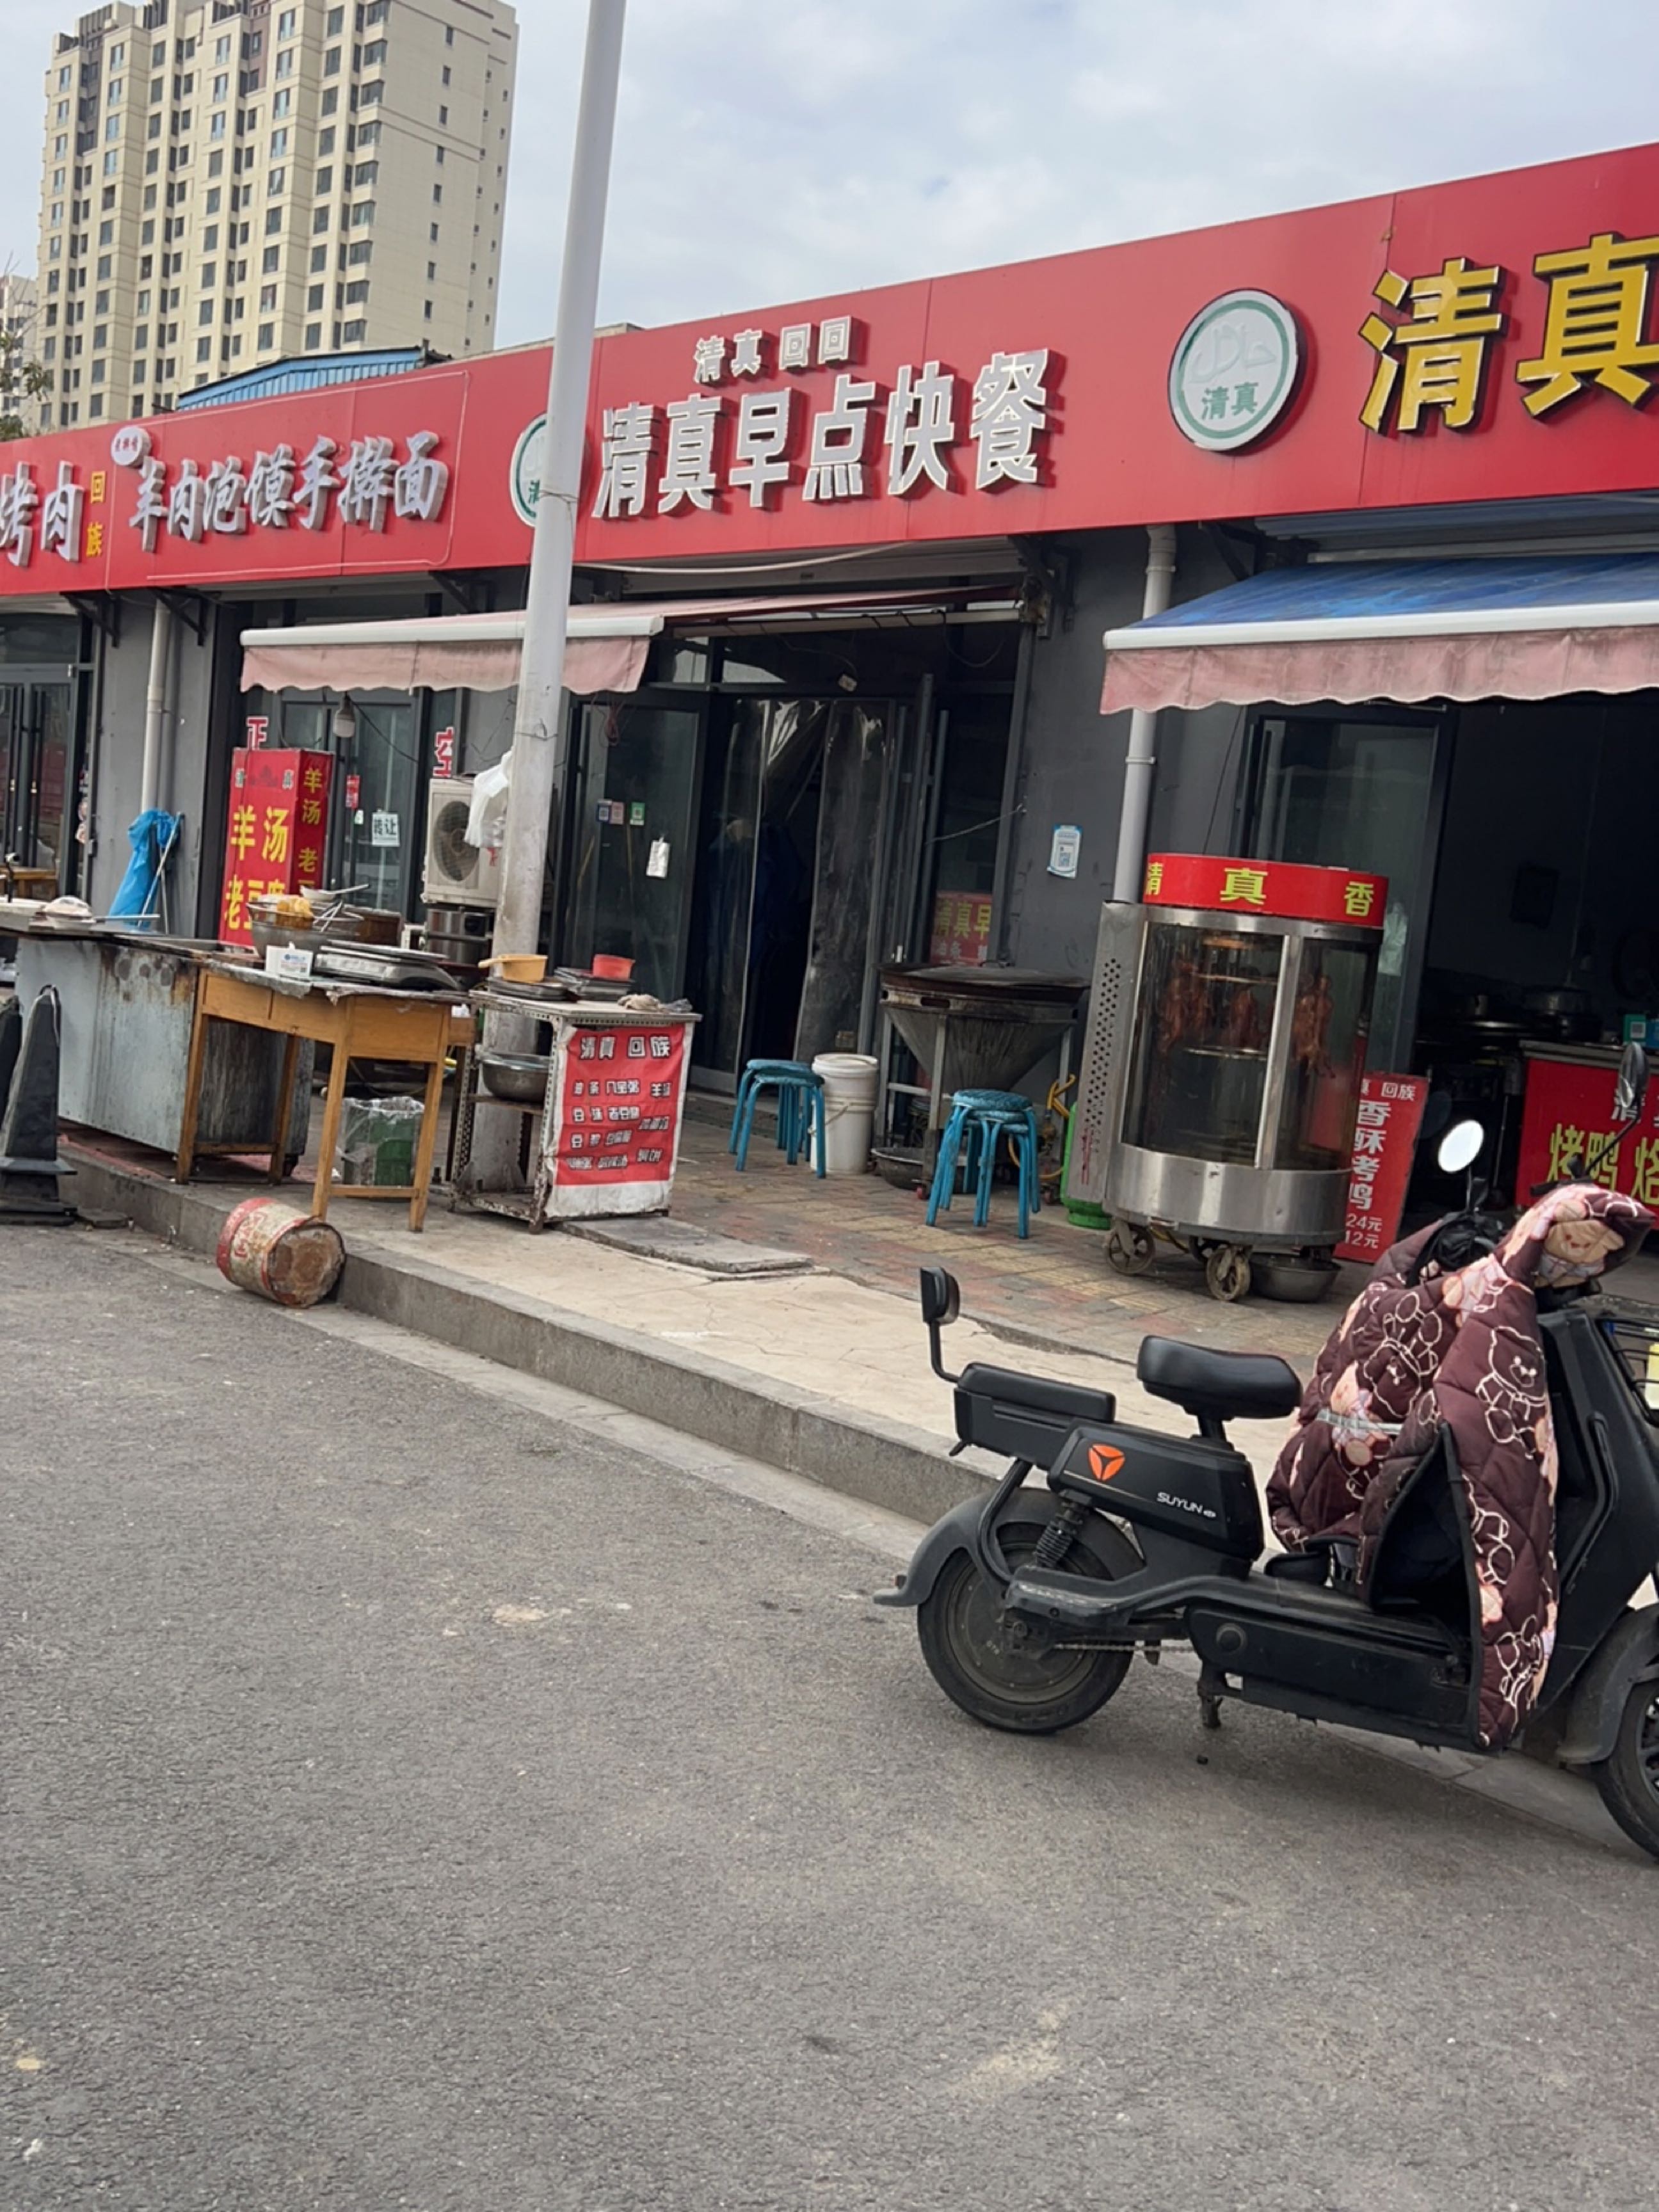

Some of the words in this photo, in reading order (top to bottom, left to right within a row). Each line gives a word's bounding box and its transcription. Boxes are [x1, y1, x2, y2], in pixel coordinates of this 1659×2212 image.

[1358, 232, 1659, 435] 清真
[1201, 381, 1258, 420] 清真
[593, 348, 1051, 519] 清真早点快餐
[86, 470, 106, 557] 回族
[302, 768, 323, 826] 羊汤
[230, 805, 290, 863] 羊汤
[1220, 867, 1269, 906] 真
[1344, 881, 1374, 917] 香
[1346, 1215, 1383, 1233] 24元
[1157, 1492, 1203, 1514] SUYUN
